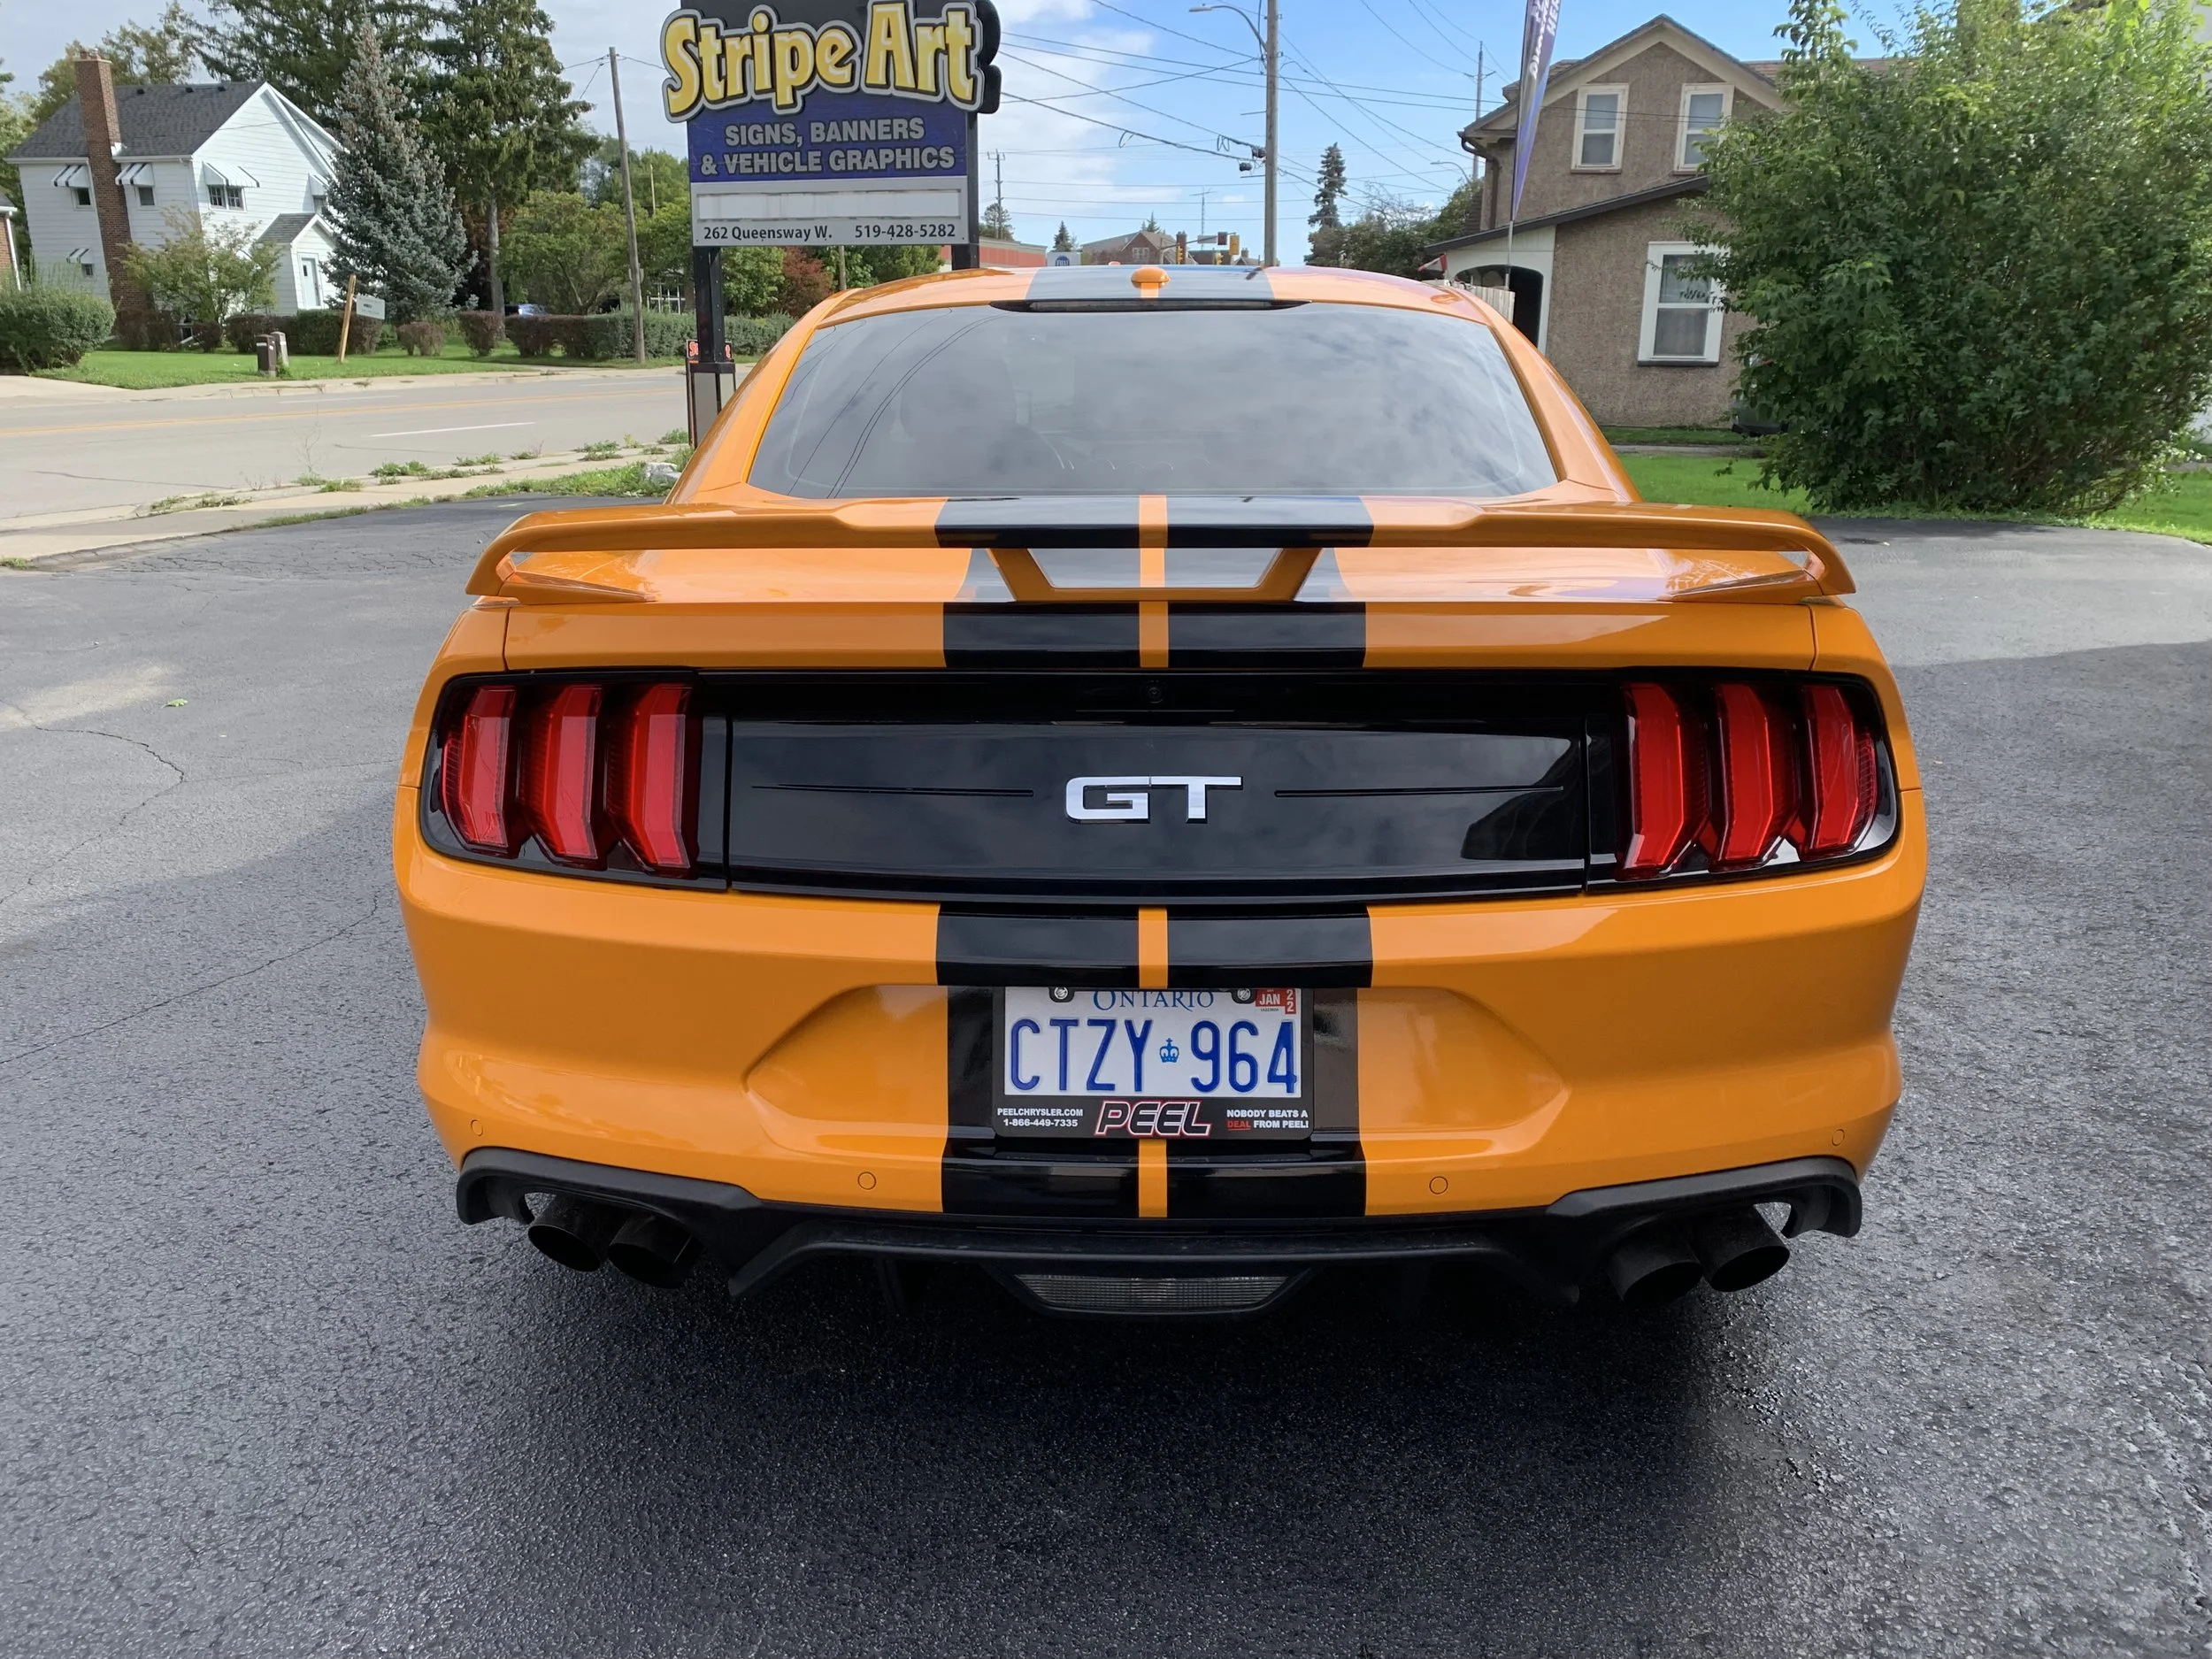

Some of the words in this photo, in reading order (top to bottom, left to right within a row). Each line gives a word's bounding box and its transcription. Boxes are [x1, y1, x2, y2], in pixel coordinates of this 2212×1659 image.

[664, 11, 853, 115] Stripe
[865, 2, 975, 102] Art
[725, 122, 803, 147] SIGNS,
[810, 117, 926, 142] BANNERS
[700, 154, 718, 175] &
[724, 150, 823, 174] VEHICLE
[828, 146, 956, 171] GRAPHICS
[703, 227, 729, 240] 262
[731, 225, 811, 242] Queensway
[814, 225, 833, 238] W.
[854, 224, 956, 238] 519-428-5282
[1065, 775, 1243, 824] GT
[1259, 993, 1281, 1006] JAN
[1010, 1018, 1153, 1092] CTZY
[1190, 1019, 1297, 1094] 964
[997, 1108, 1083, 1117] PEELCHRYSLER.COM
[1094, 1100, 1212, 1137] PEEL
[1226, 1109, 1266, 1118] NOBODY
[1268, 1110, 1299, 1118] BEATS
[1002, 1118, 1079, 1127] 1-866-449-7335
[1226, 1120, 1251, 1129] DEAL
